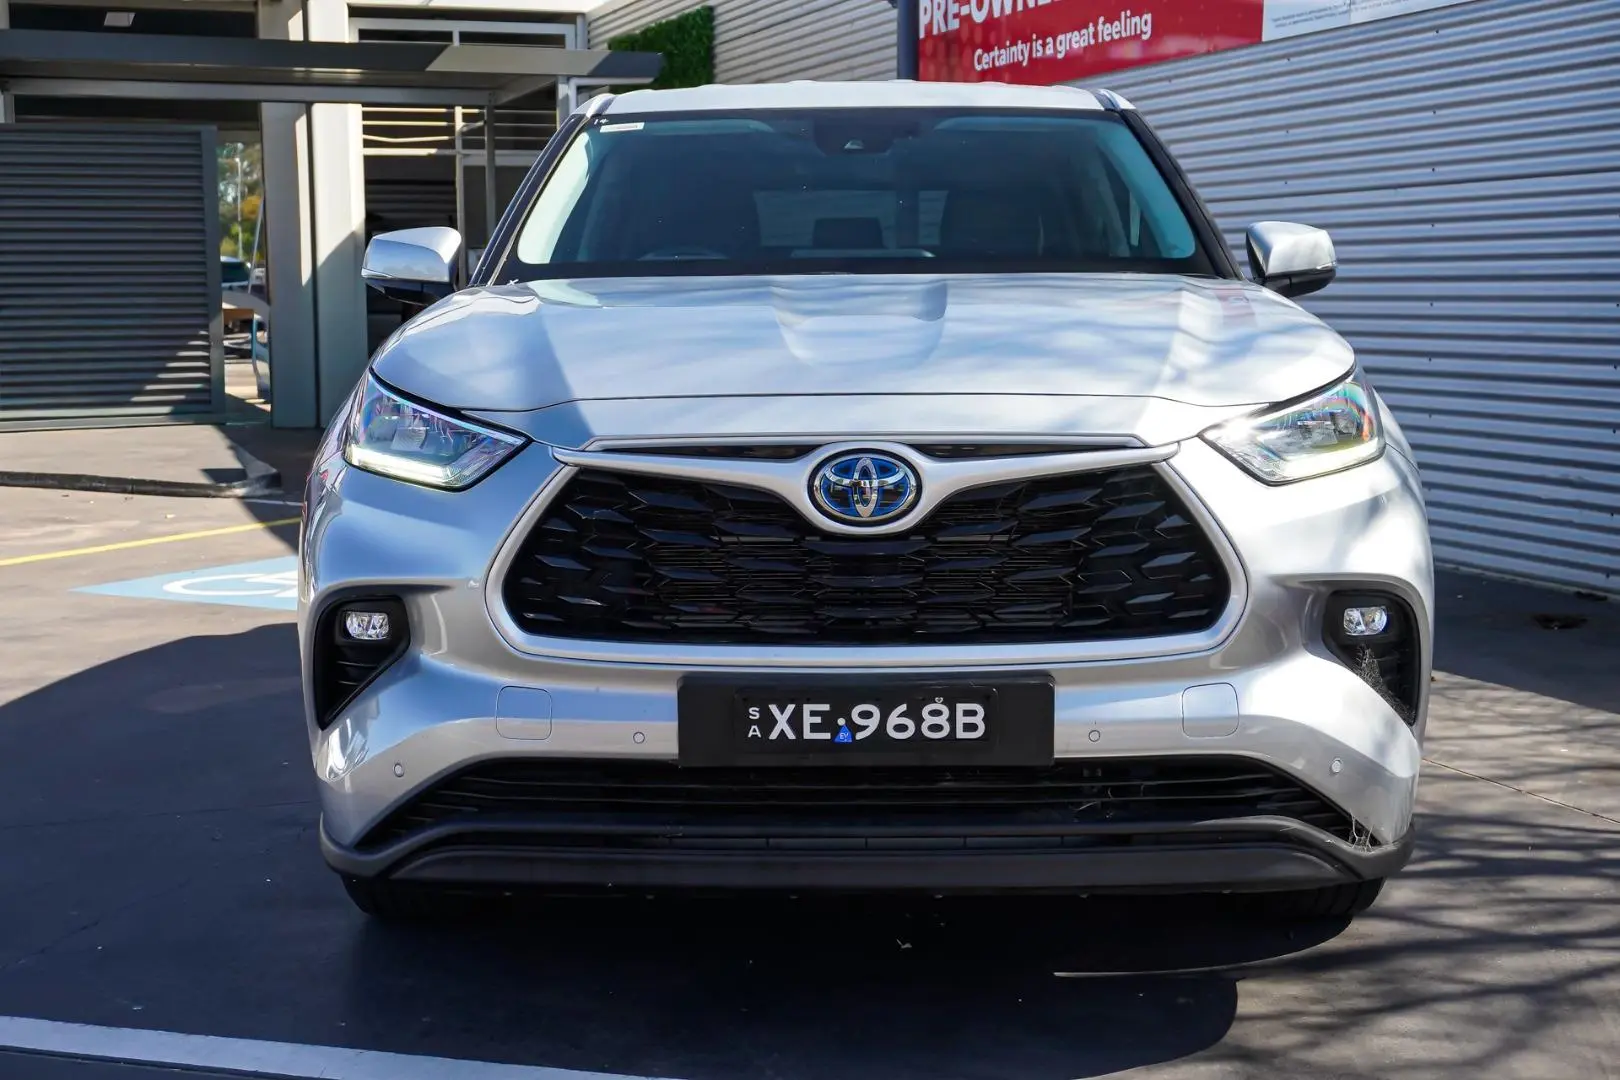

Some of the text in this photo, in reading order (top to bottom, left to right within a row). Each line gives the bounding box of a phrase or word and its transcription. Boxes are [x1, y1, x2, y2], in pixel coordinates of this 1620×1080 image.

[919, 0, 1052, 39] PRE-O
[973, 10, 1152, 71] Certainty is a great feeling
